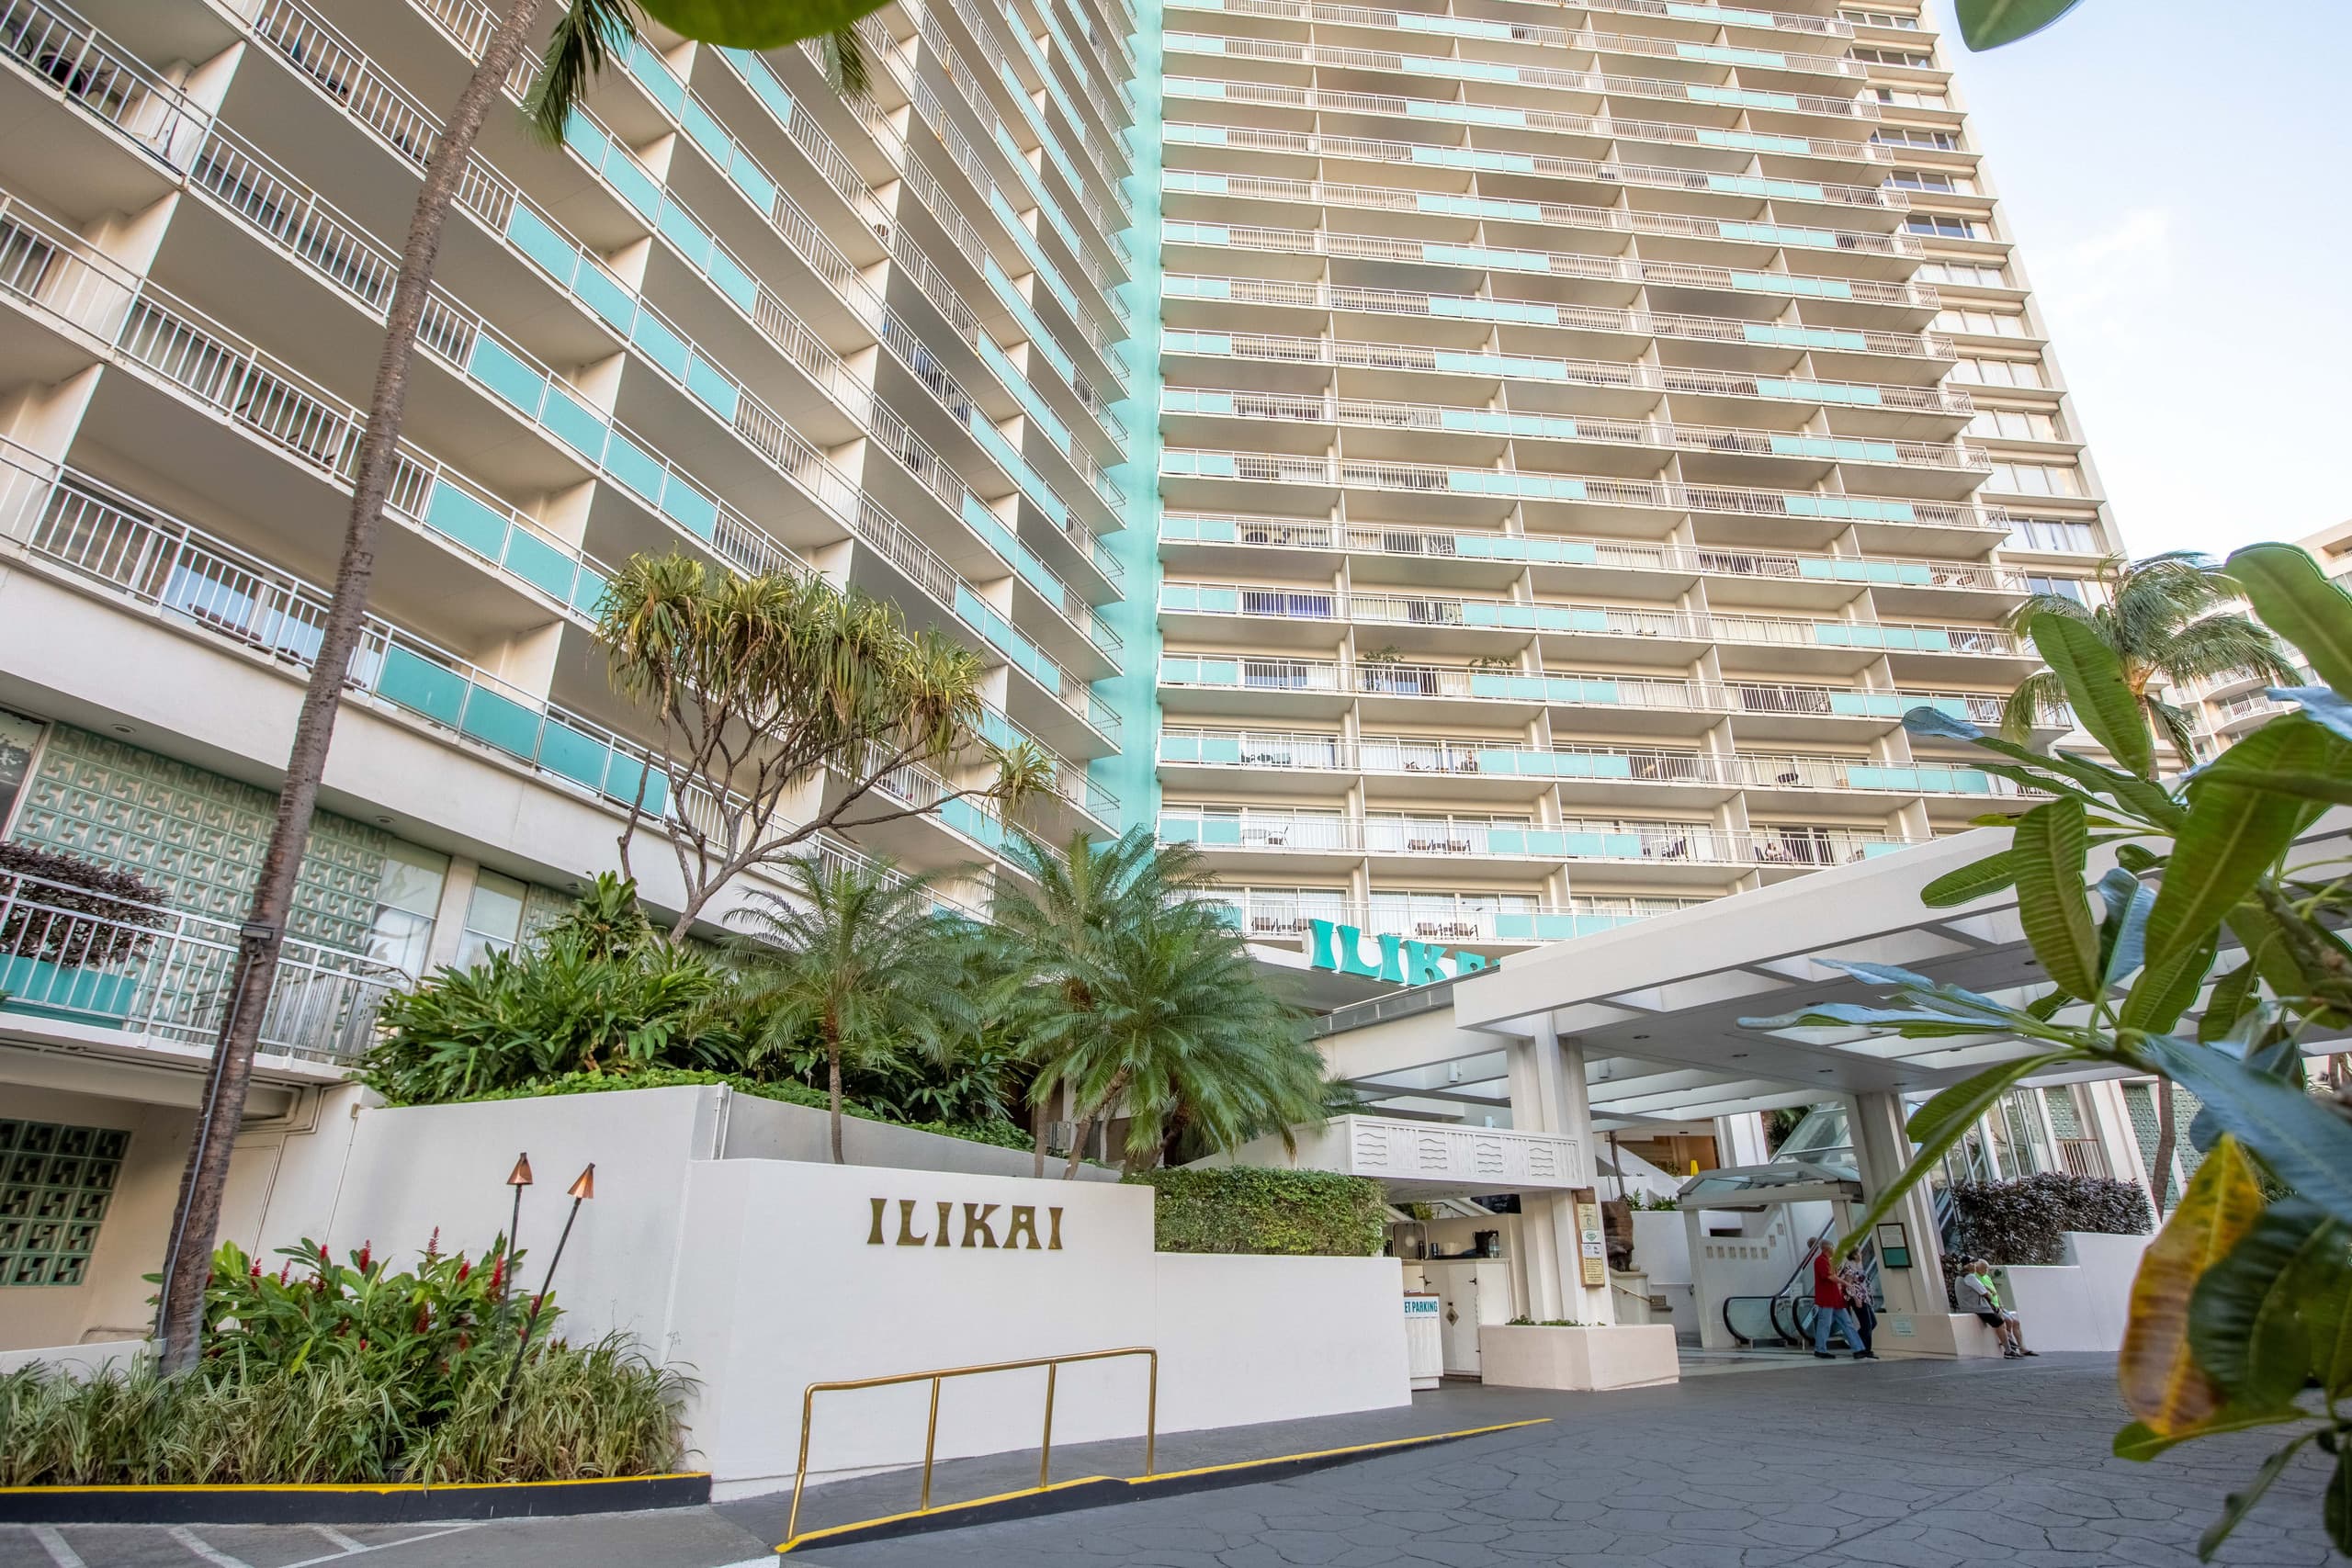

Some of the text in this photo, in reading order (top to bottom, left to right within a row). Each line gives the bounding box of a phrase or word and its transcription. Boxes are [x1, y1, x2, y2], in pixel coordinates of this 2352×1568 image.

[1308, 919, 1499, 986] ILIK
[867, 1198, 1064, 1249] ILIKAI
[1412, 1300, 1438, 1313] PARKING
